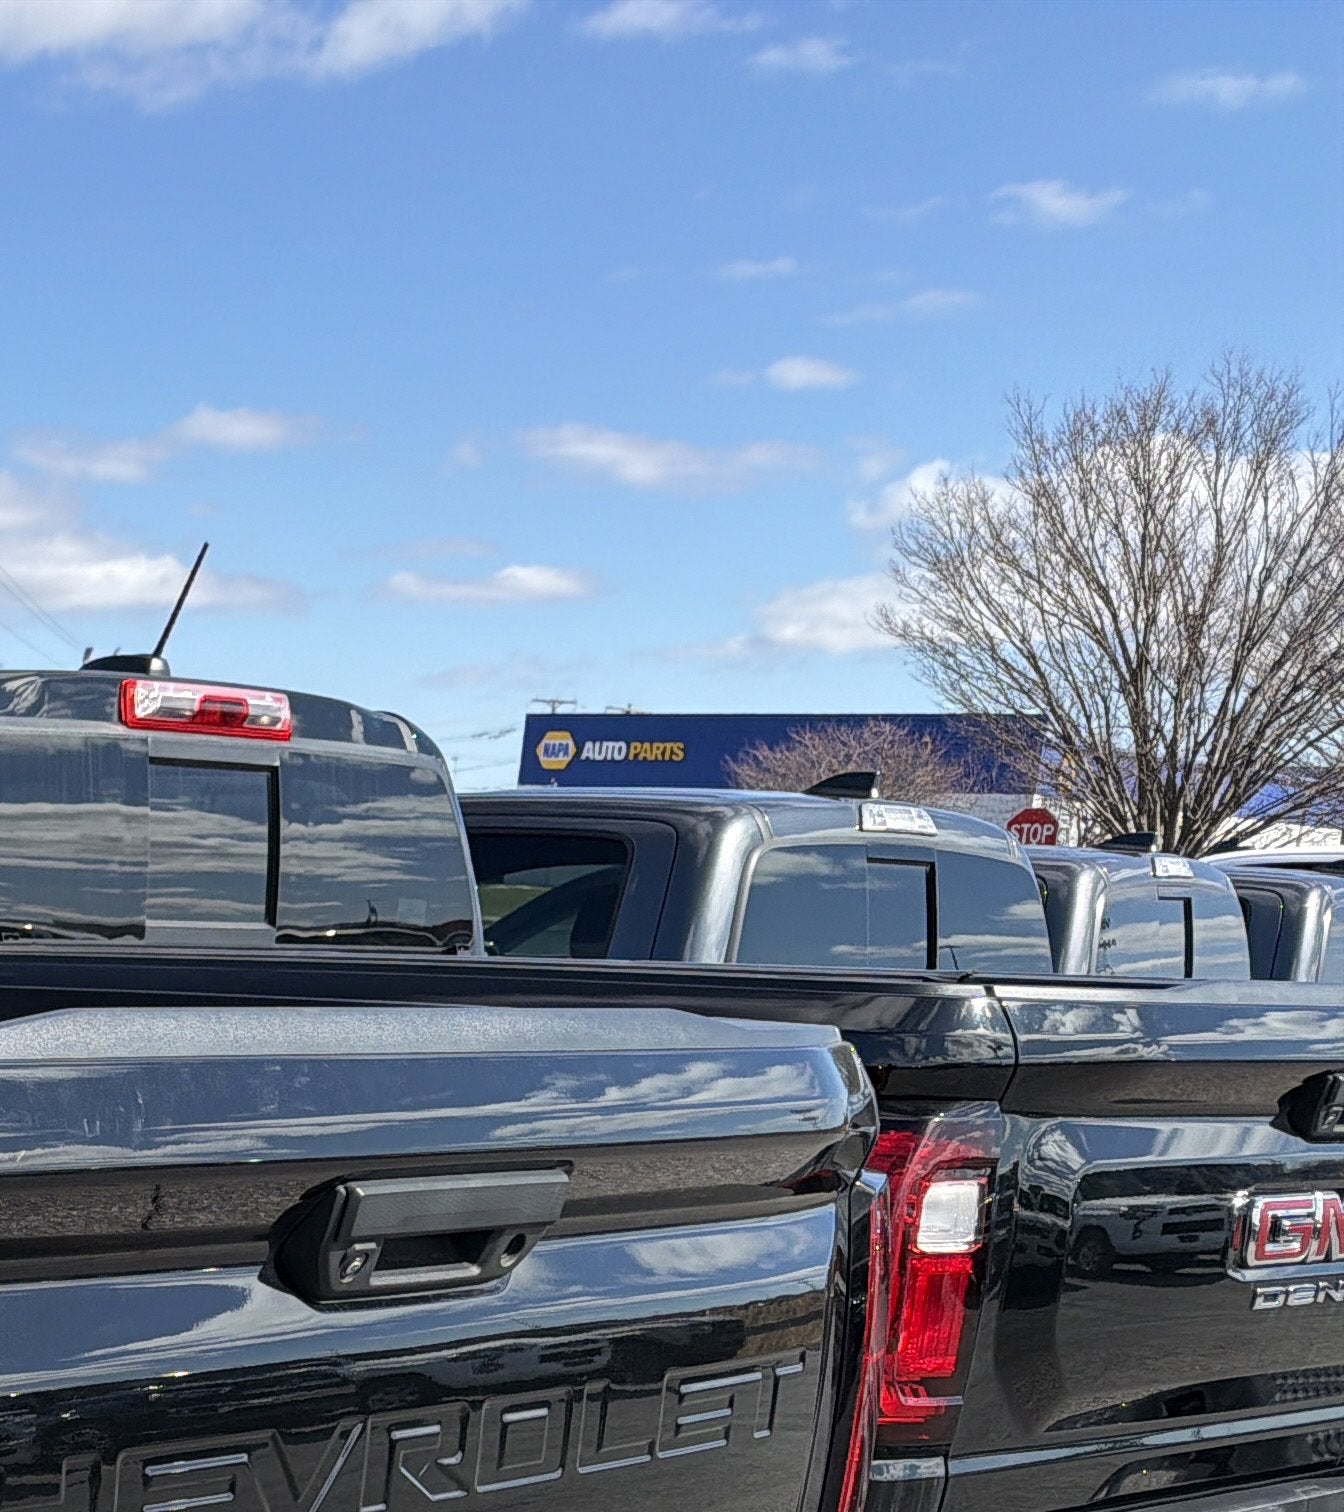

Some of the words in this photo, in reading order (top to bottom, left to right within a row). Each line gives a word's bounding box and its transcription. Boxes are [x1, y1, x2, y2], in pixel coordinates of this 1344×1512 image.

[543, 742, 570, 759] NAPA
[580, 740, 627, 761] AUTO
[628, 742, 685, 761] PARTS
[1010, 822, 1055, 845] STOP
